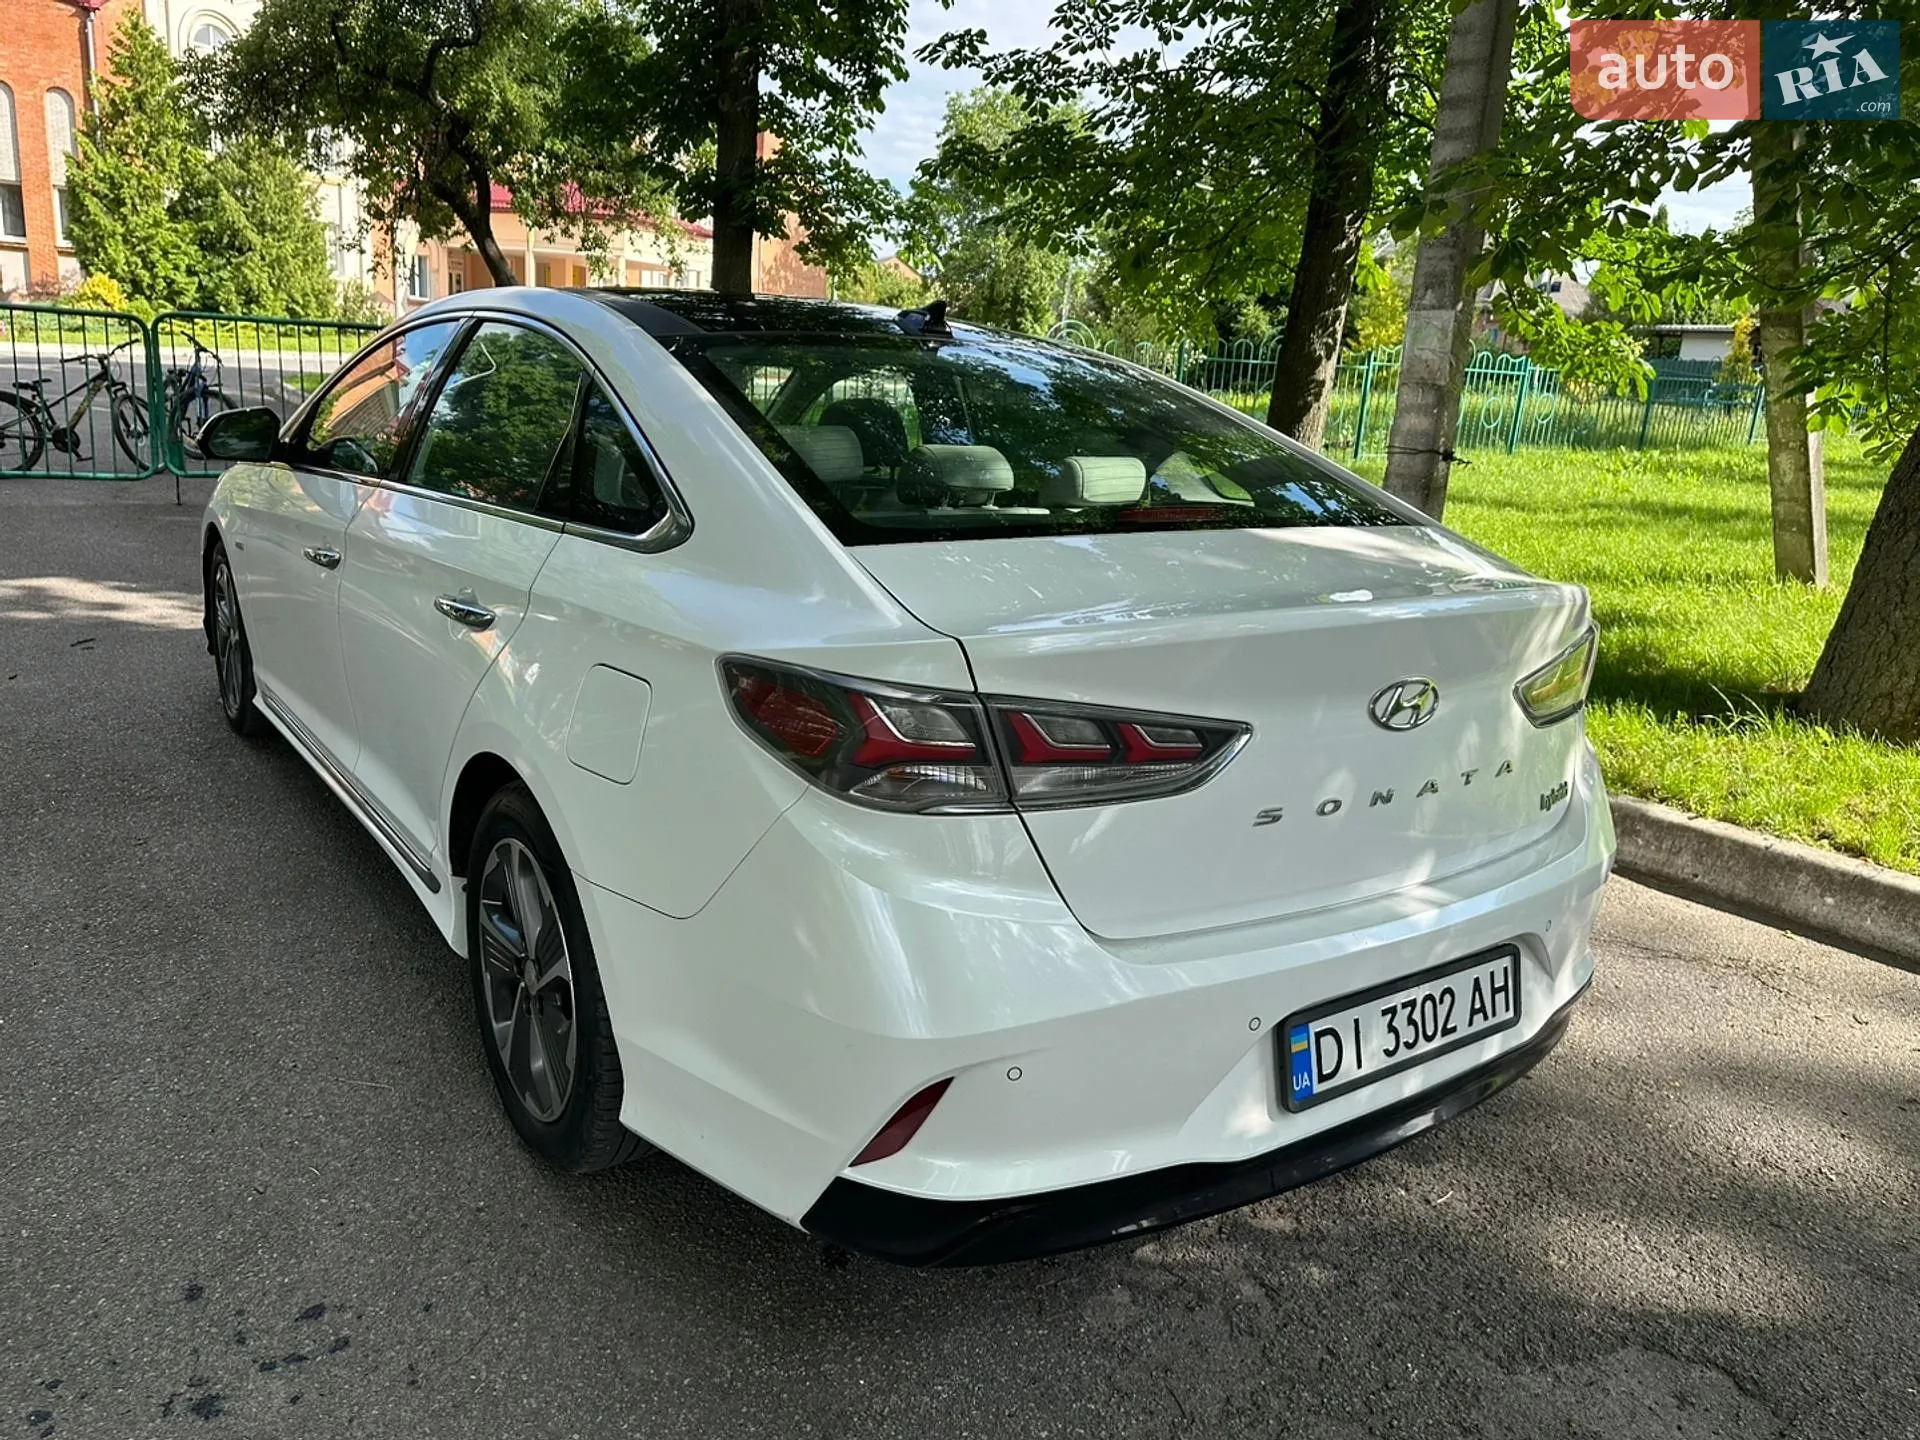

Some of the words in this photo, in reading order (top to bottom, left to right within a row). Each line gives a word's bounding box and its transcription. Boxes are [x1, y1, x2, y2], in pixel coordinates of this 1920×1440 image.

[1253, 759, 1513, 827] SONATA
[1314, 1017, 1363, 1084] DI
[1380, 986, 1458, 1057] 3302
[1467, 965, 1510, 1027] AH
[1293, 1071, 1311, 1091] UA
